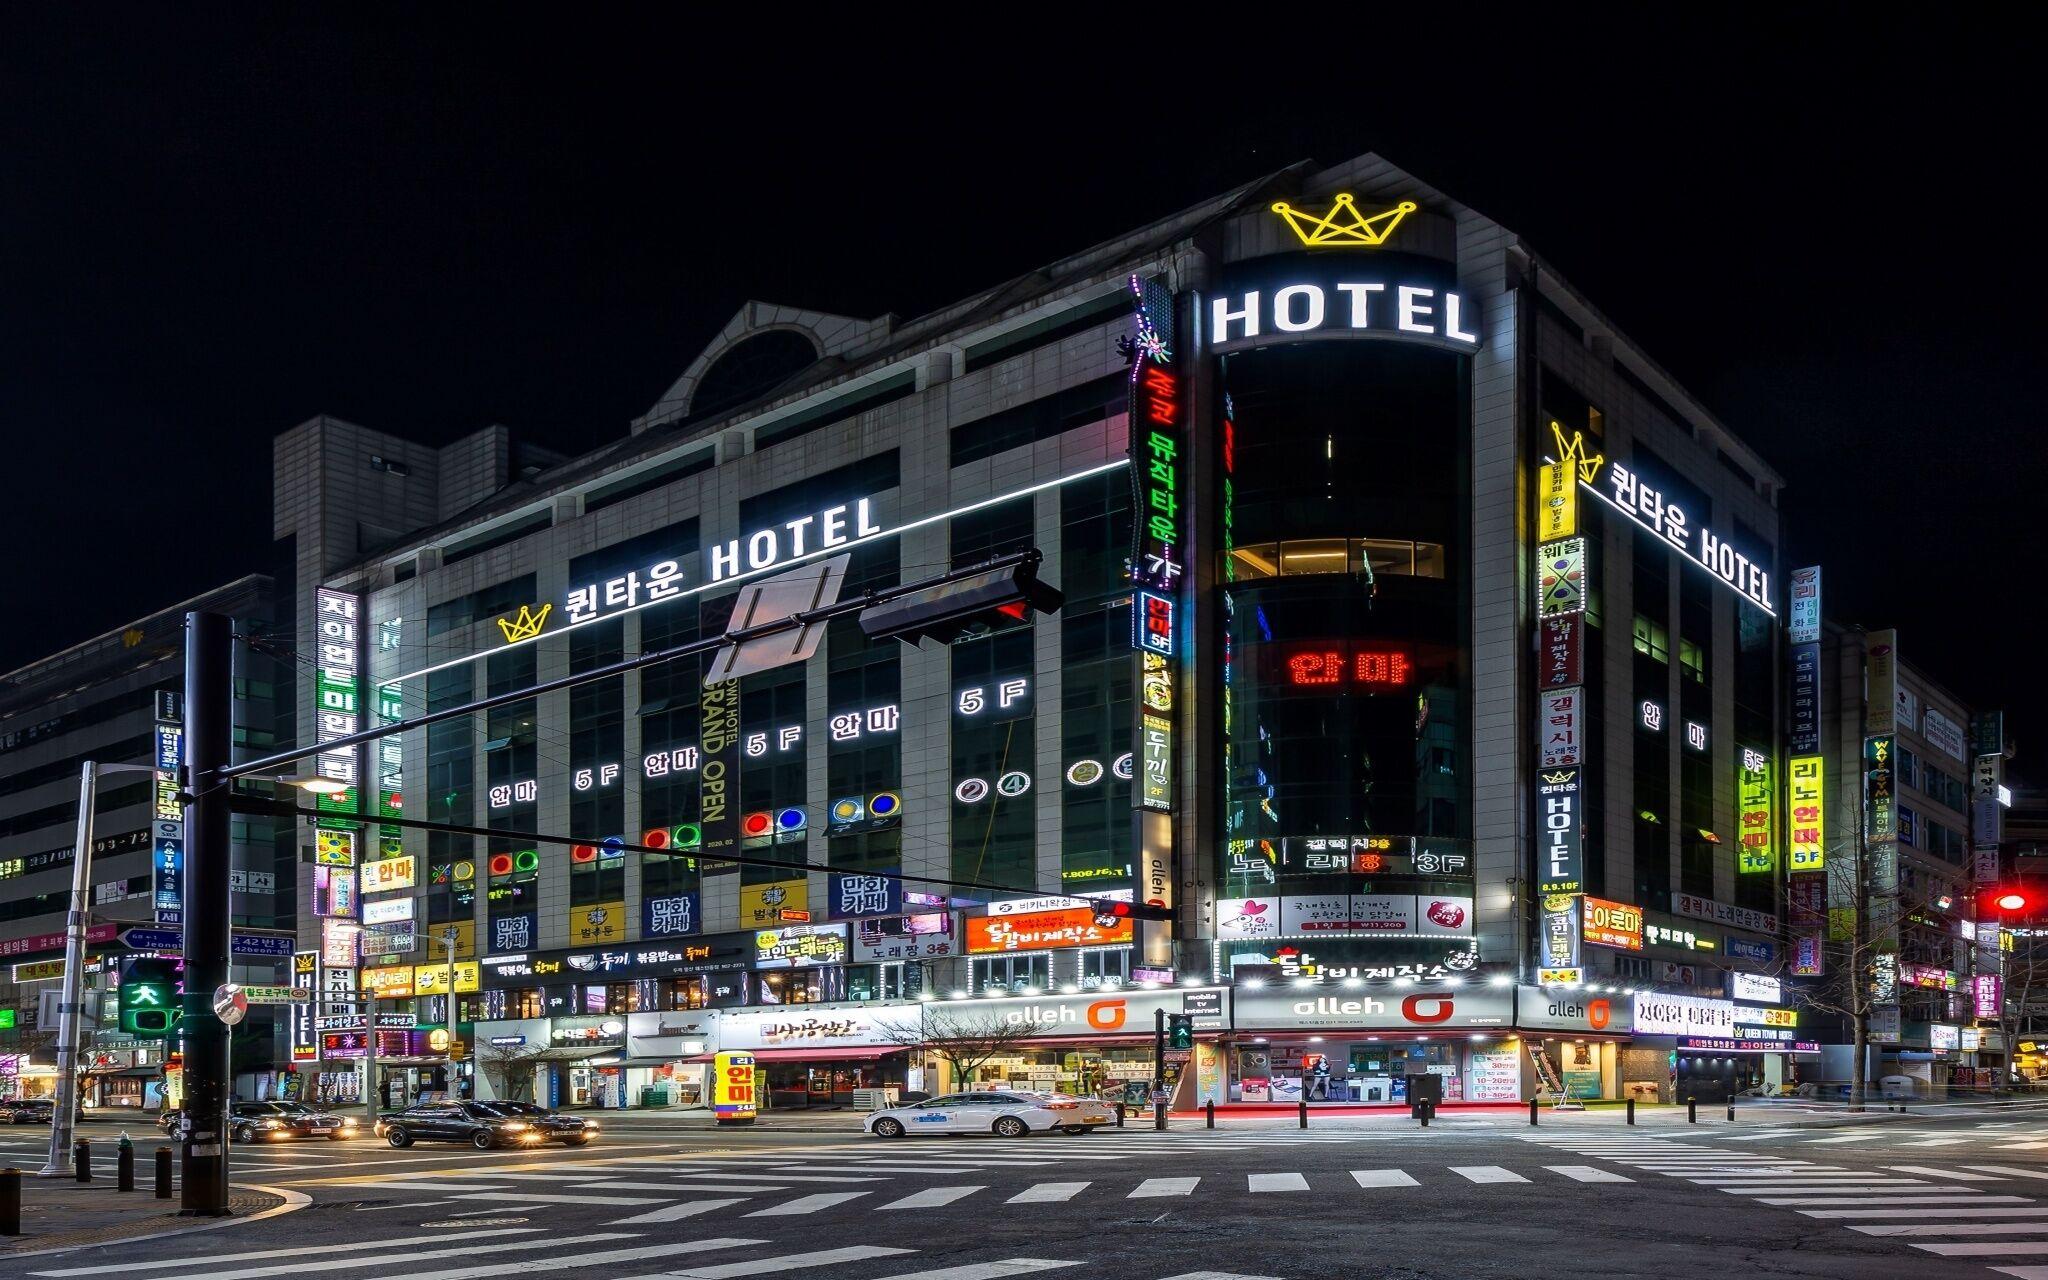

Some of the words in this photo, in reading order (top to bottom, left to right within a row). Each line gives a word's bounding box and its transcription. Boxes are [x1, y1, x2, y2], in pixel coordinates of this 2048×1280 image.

[1212, 283, 1476, 344] HOTEL
[1148, 431, 1177, 545] 뮤직타운
[1610, 461, 1689, 549] 퀸타운
[1702, 527, 1772, 609] HOTEL
[564, 560, 684, 624] 퀸타운
[711, 497, 881, 581] HOTEL
[1145, 553, 1182, 578] 7F
[1151, 634, 1170, 649] 5F
[1289, 652, 1409, 684] 안마
[726, 677, 738, 706] OWN
[959, 688, 983, 715] 5
[1000, 679, 1026, 708] F
[702, 675, 726, 754] GRAND
[830, 704, 900, 741] 안마
[1549, 696, 1573, 745] 갤럭시
[726, 709, 738, 747] HOTEL
[1643, 701, 1705, 750] 안마
[747, 732, 767, 756] 5
[779, 725, 801, 751] F
[643, 747, 699, 778] 안마
[1146, 731, 1168, 774] 두끼
[1545, 755, 1576, 766] 3층
[1744, 749, 1764, 773] 5F
[575, 769, 593, 791] 5
[601, 764, 619, 785] F
[1004, 775, 1022, 793] 4
[489, 779, 538, 808] 안마
[702, 760, 726, 823] OPEN
[1151, 787, 1163, 796] 2F
[1540, 784, 1578, 795] 퀸타운
[1793, 763, 1821, 844] 리노안마
[1369, 838, 1391, 849] 3층
[1547, 797, 1571, 877] HOTEL
[1417, 853, 1466, 873] 3F
[1794, 851, 1819, 864] 5F
[378, 859, 412, 883] 안마
[1152, 859, 1166, 895] olleh
[841, 875, 889, 896] 만화
[651, 896, 691, 916] 만화
[841, 892, 889, 913] 카페
[1293, 901, 1344, 911] 국내최초
[651, 912, 691, 934] 카페
[1594, 907, 1640, 933] 아로마
[1680, 896, 1714, 918] 갤럭시
[1717, 904, 1762, 929] 노래연습장
[1763, 916, 1776, 931] 3층
[497, 916, 529, 934] 만화
[497, 931, 529, 949] 카페
[777, 934, 816, 947] COINJOY
[871, 945, 920, 959] 노래짱
[926, 942, 950, 955] 3층
[600, 951, 628, 971] 두끼
[637, 949, 683, 965] 볶음밥으로
[685, 946, 710, 962] 두끼!
[826, 951, 844, 963] 2F
[1549, 957, 1571, 968] 2F
[25, 960, 64, 976] 대화방
[533, 960, 561, 974] 한끼!
[1363, 962, 1453, 983] 제작소
[243, 986, 291, 999] 활도로구역
[1187, 993, 1217, 1001] mobile
[299, 973, 312, 1046] HTEL
[1007, 1004, 1076, 1026] olleh
[1294, 997, 1384, 1016] olleh
[1548, 1002, 1584, 1019] olleh
[1774, 1011, 1791, 1025] 안마
[1744, 1028, 1762, 1039] QUEEN
[1761, 1029, 1778, 1040] TOWN
[1740, 1041, 1786, 1050] 자이언트
[726, 1067, 752, 1102] 안마
